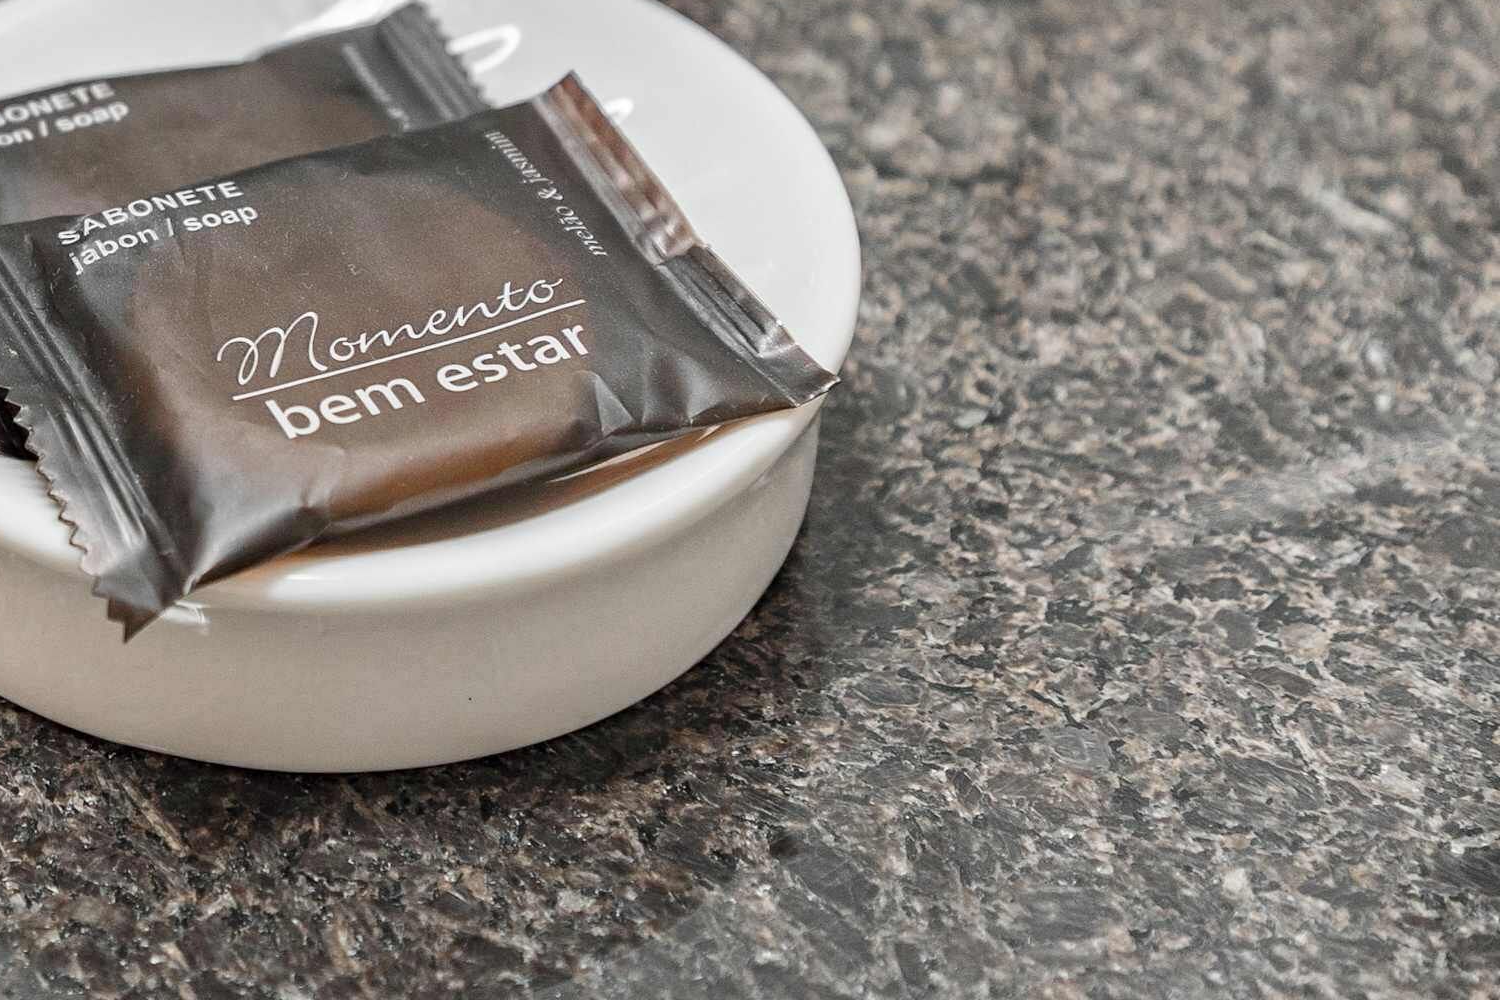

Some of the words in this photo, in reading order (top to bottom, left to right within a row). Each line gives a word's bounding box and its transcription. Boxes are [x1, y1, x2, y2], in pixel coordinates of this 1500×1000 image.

[37, 119, 50, 138] /
[54, 101, 130, 133] soap
[57, 180, 244, 246] SABONETE
[538, 187, 563, 201] &
[165, 217, 175, 238] /
[182, 205, 259, 232] soap
[556, 206, 609, 256] melão
[216, 278, 563, 385] Momento
[264, 377, 426, 440] bem
[436, 325, 590, 393] estar
